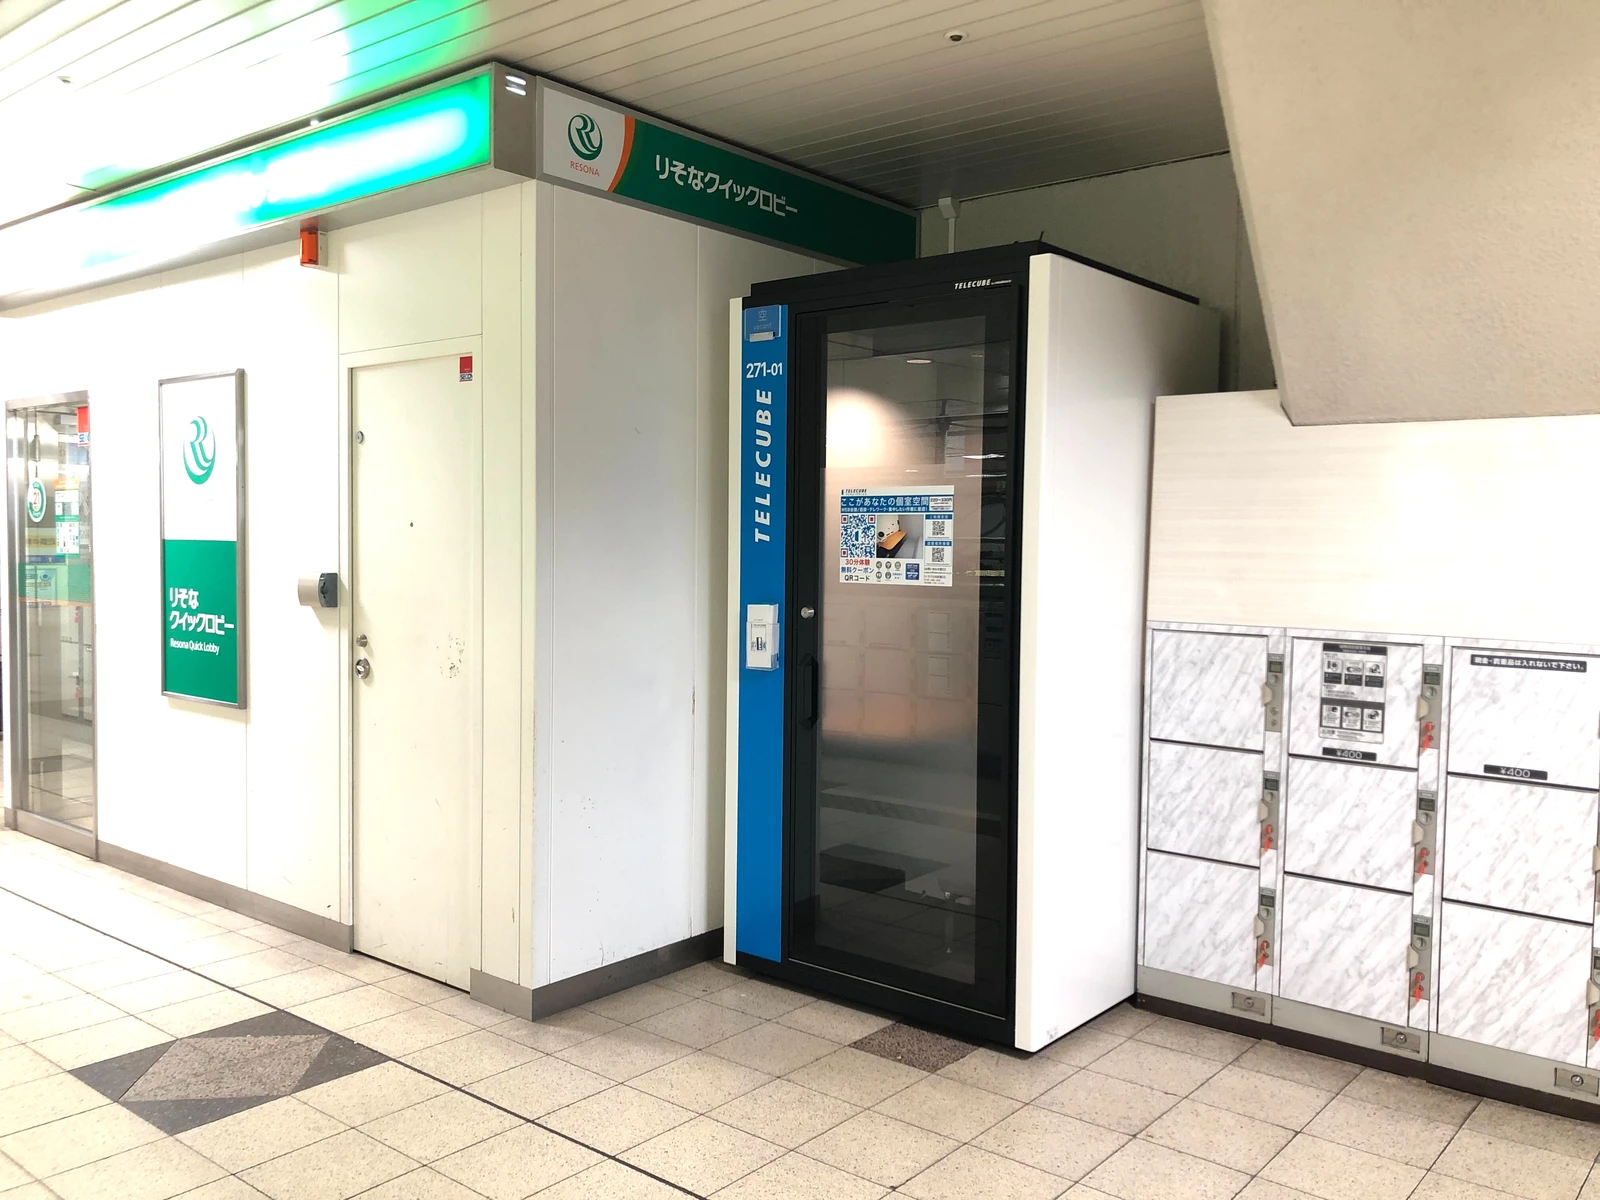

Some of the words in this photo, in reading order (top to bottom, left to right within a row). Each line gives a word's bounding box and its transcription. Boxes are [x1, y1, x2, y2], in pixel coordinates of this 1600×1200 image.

[570, 160, 600, 177] RESONA
[655, 154, 798, 217] りそなクイックロビー
[954, 278, 991, 290] TELECUBE
[746, 363, 782, 378] 271-01
[755, 390, 771, 542] TELECUBE
[841, 497, 928, 506] ここがあなたの個室空間
[169, 587, 199, 609] りそな
[169, 611, 234, 635] クイックロビー
[170, 638, 189, 649] Resona
[189, 640, 204, 651] Quick
[203, 642, 220, 655] Lobby
[1336, 749, 1363, 760] ¥400
[1500, 767, 1531, 779] ¥400
